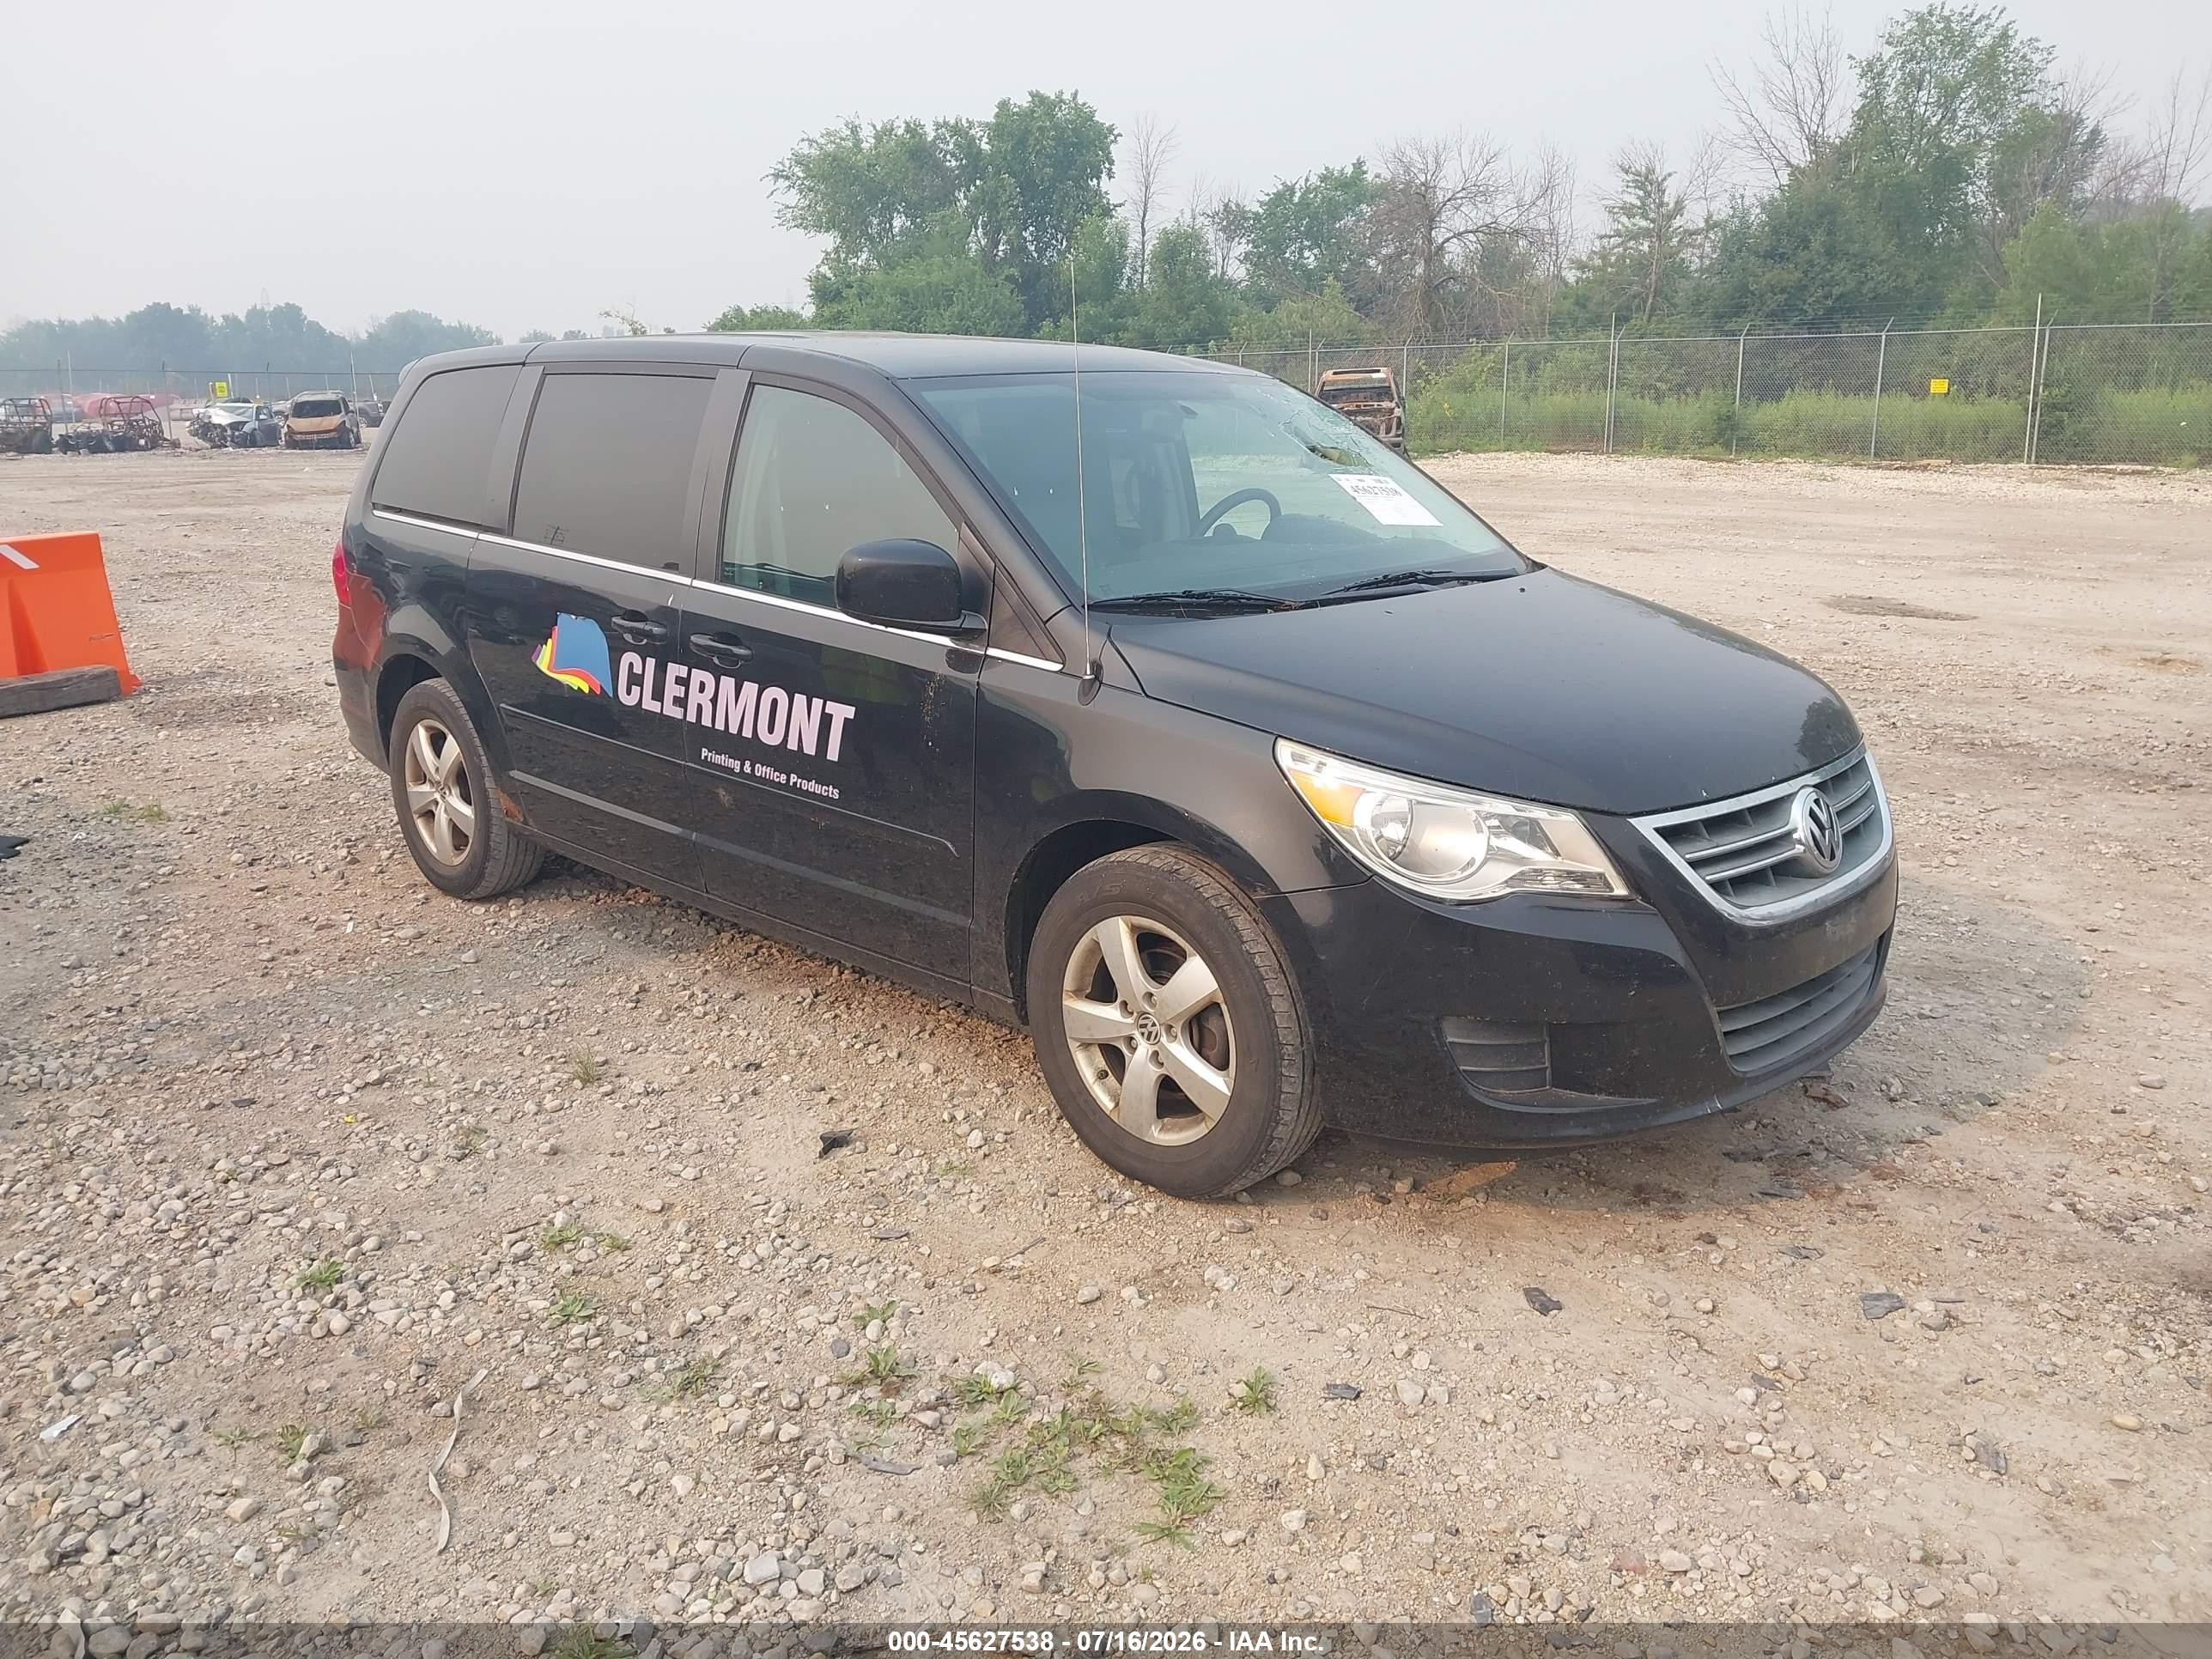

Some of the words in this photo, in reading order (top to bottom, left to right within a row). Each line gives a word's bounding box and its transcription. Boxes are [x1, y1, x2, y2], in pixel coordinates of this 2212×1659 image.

[1351, 486, 1402, 496] 45627538
[617, 652, 856, 762] CLERMONT
[701, 747, 741, 775] Printing
[744, 760, 751, 774] &
[754, 763, 787, 784] Office
[790, 773, 840, 799] Products
